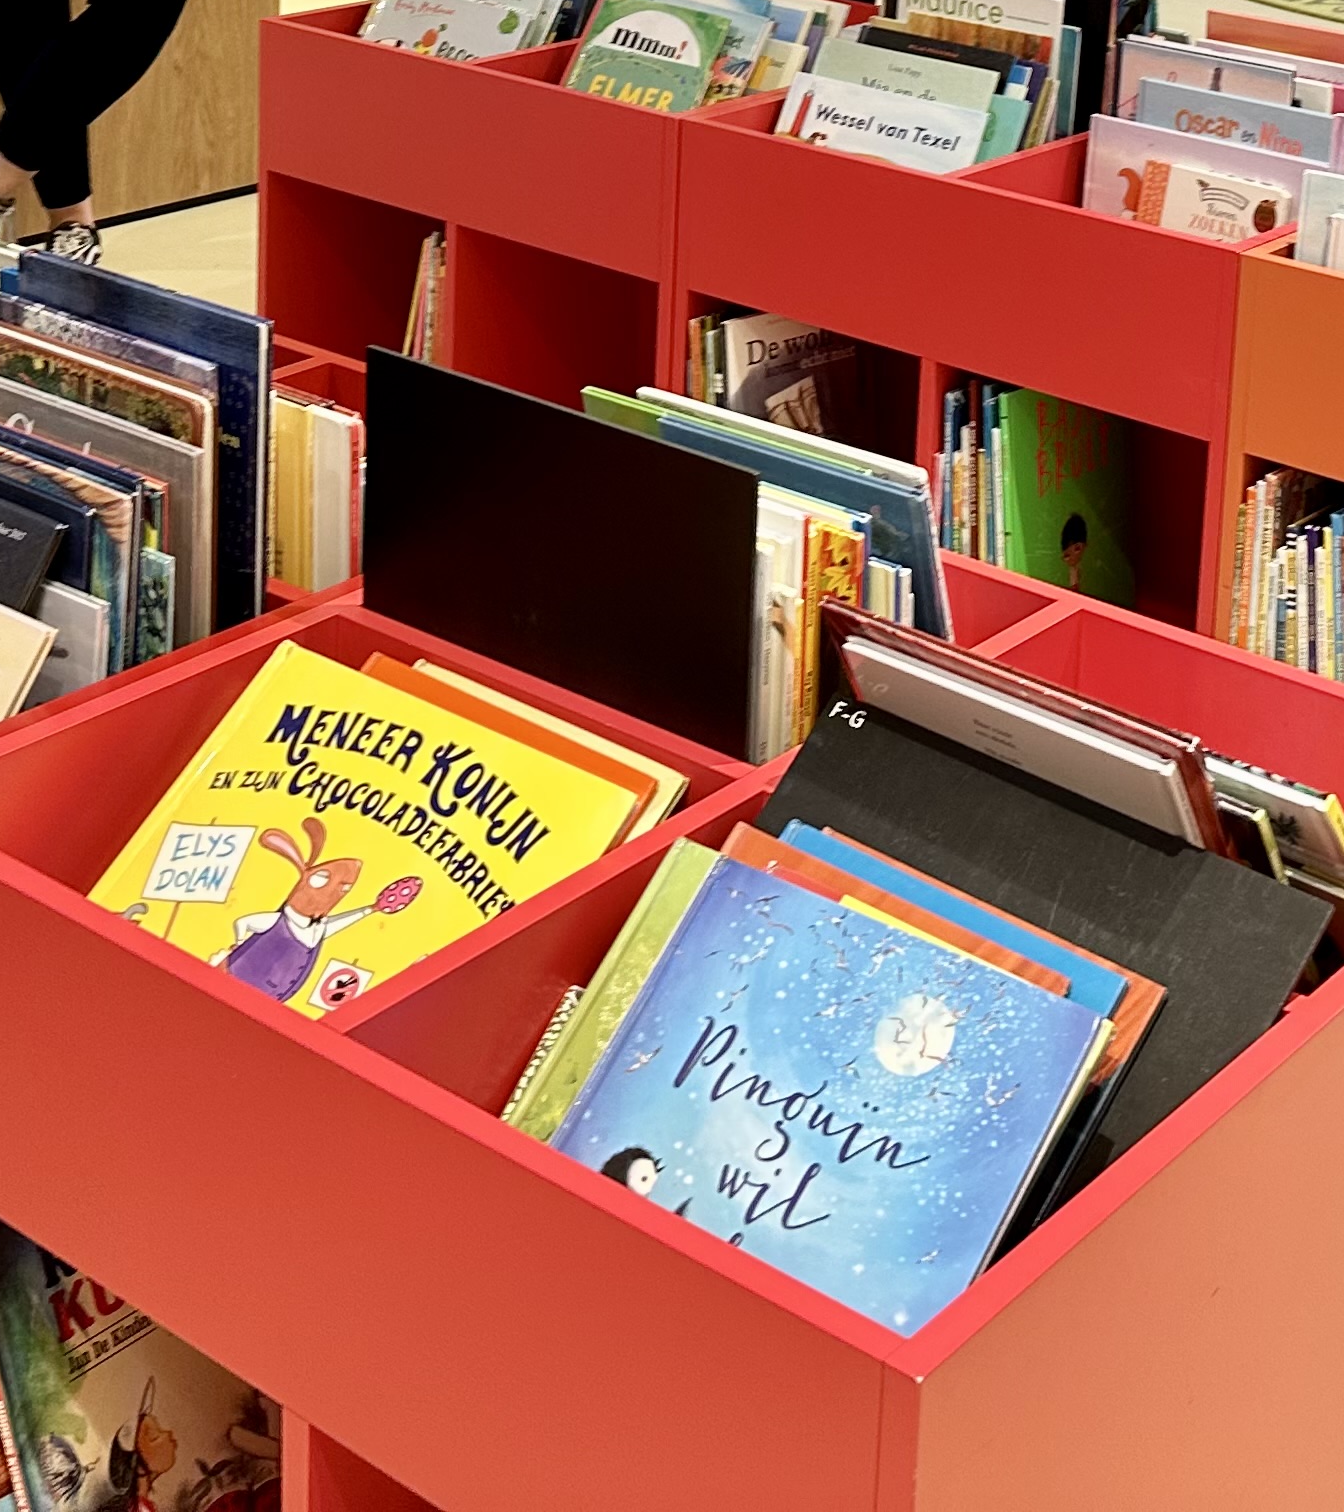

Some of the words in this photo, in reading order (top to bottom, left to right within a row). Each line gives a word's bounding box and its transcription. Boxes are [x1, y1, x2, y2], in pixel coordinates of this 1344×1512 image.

[816, 103, 875, 132] Wessel
[876, 122, 908, 142] van
[912, 125, 962, 152] Texel
[1174, 108, 1240, 138] Oscar
[746, 339, 779, 366] De
[828, 700, 867, 730] F-G
[209, 771, 237, 790] EN
[240, 770, 287, 791] ZIJN
[265, 704, 423, 774] MENEER
[420, 741, 552, 865] KONIJN
[171, 833, 237, 861] ELYS
[154, 865, 228, 893] DOLAN
[673, 1015, 931, 1168] Pinguïn
[717, 1163, 831, 1229] wil
